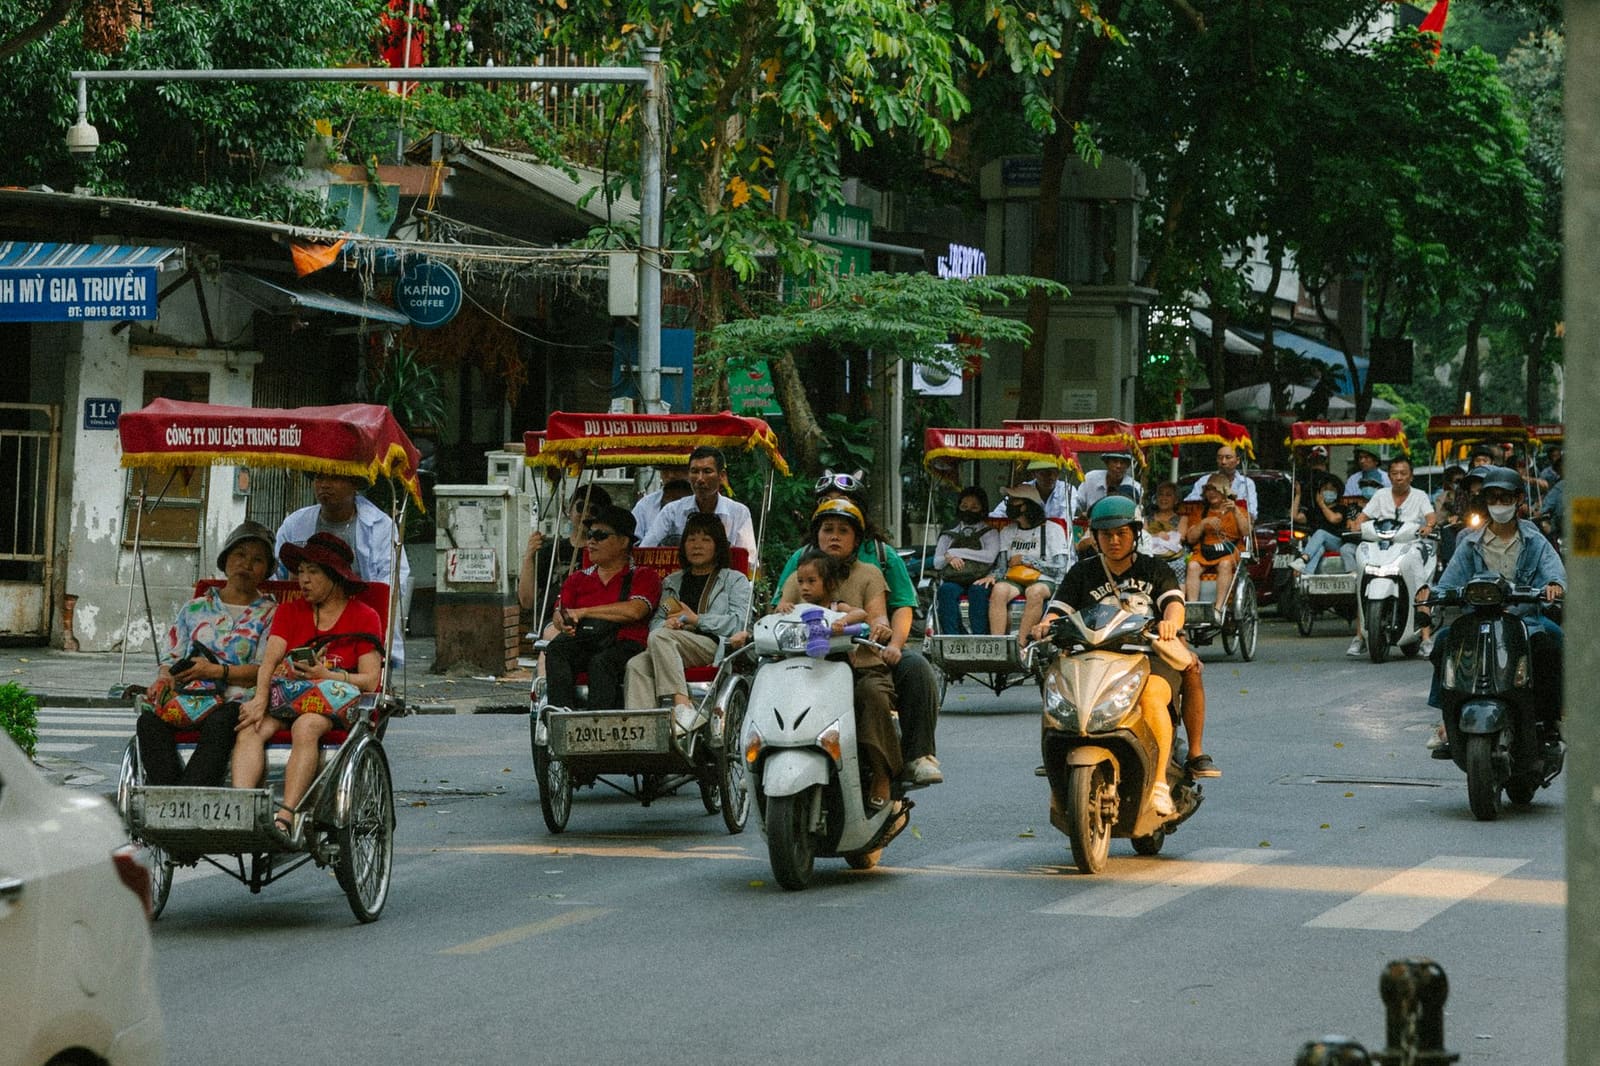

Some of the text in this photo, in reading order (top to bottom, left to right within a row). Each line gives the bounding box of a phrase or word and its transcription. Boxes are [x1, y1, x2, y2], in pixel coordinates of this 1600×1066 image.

[19, 273, 45, 303] MỲ
[50, 277, 78, 302] GIA
[82, 269, 147, 301] TRUYỀN
[404, 285, 450, 296] KAFINO
[410, 299, 445, 308] COFFEE
[84, 306, 108, 317] 0919
[110, 306, 126, 316] 821
[129, 305, 147, 316] 311
[165, 423, 192, 446] CÔNG
[193, 428, 206, 446] TY
[208, 428, 221, 446] DU
[245, 428, 278, 446] TRUNG
[279, 424, 302, 447] HIẾU
[584, 420, 600, 436] DU
[631, 421, 669, 434] TRUNG
[944, 434, 956, 446] DU
[977, 435, 1004, 448] TRUNG
